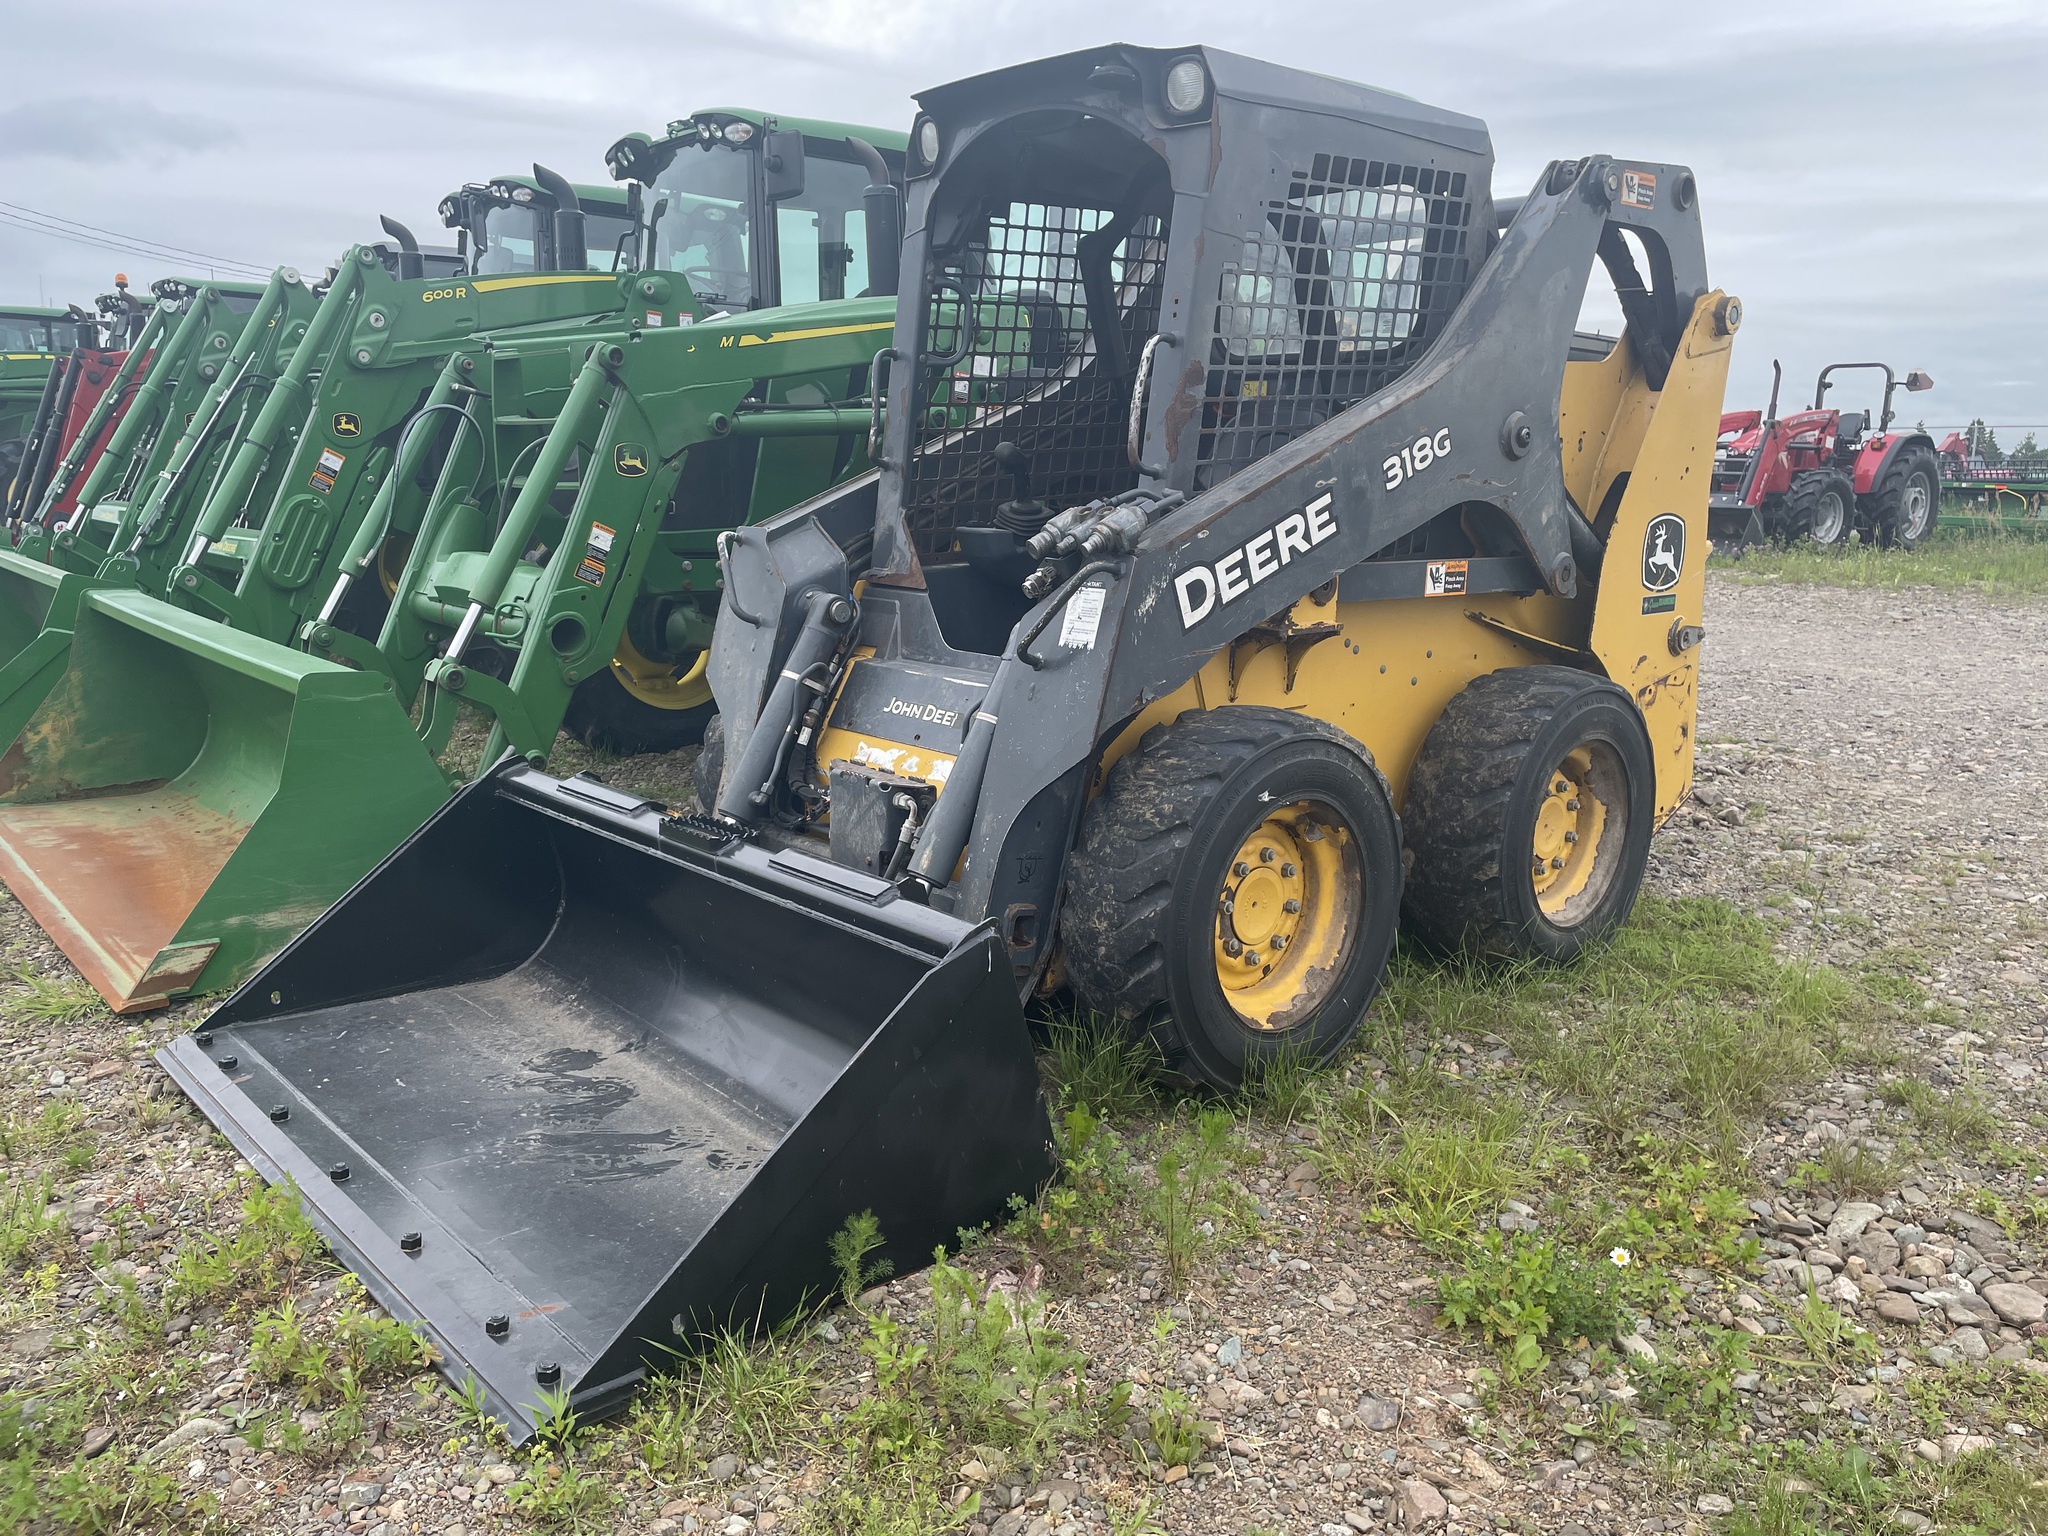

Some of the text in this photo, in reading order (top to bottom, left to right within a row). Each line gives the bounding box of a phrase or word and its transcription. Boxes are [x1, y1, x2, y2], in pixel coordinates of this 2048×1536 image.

[719, 335, 734, 348] M
[1382, 427, 1452, 491] 318G
[1174, 492, 1338, 631] DEERE
[882, 696, 924, 719] JOHN
